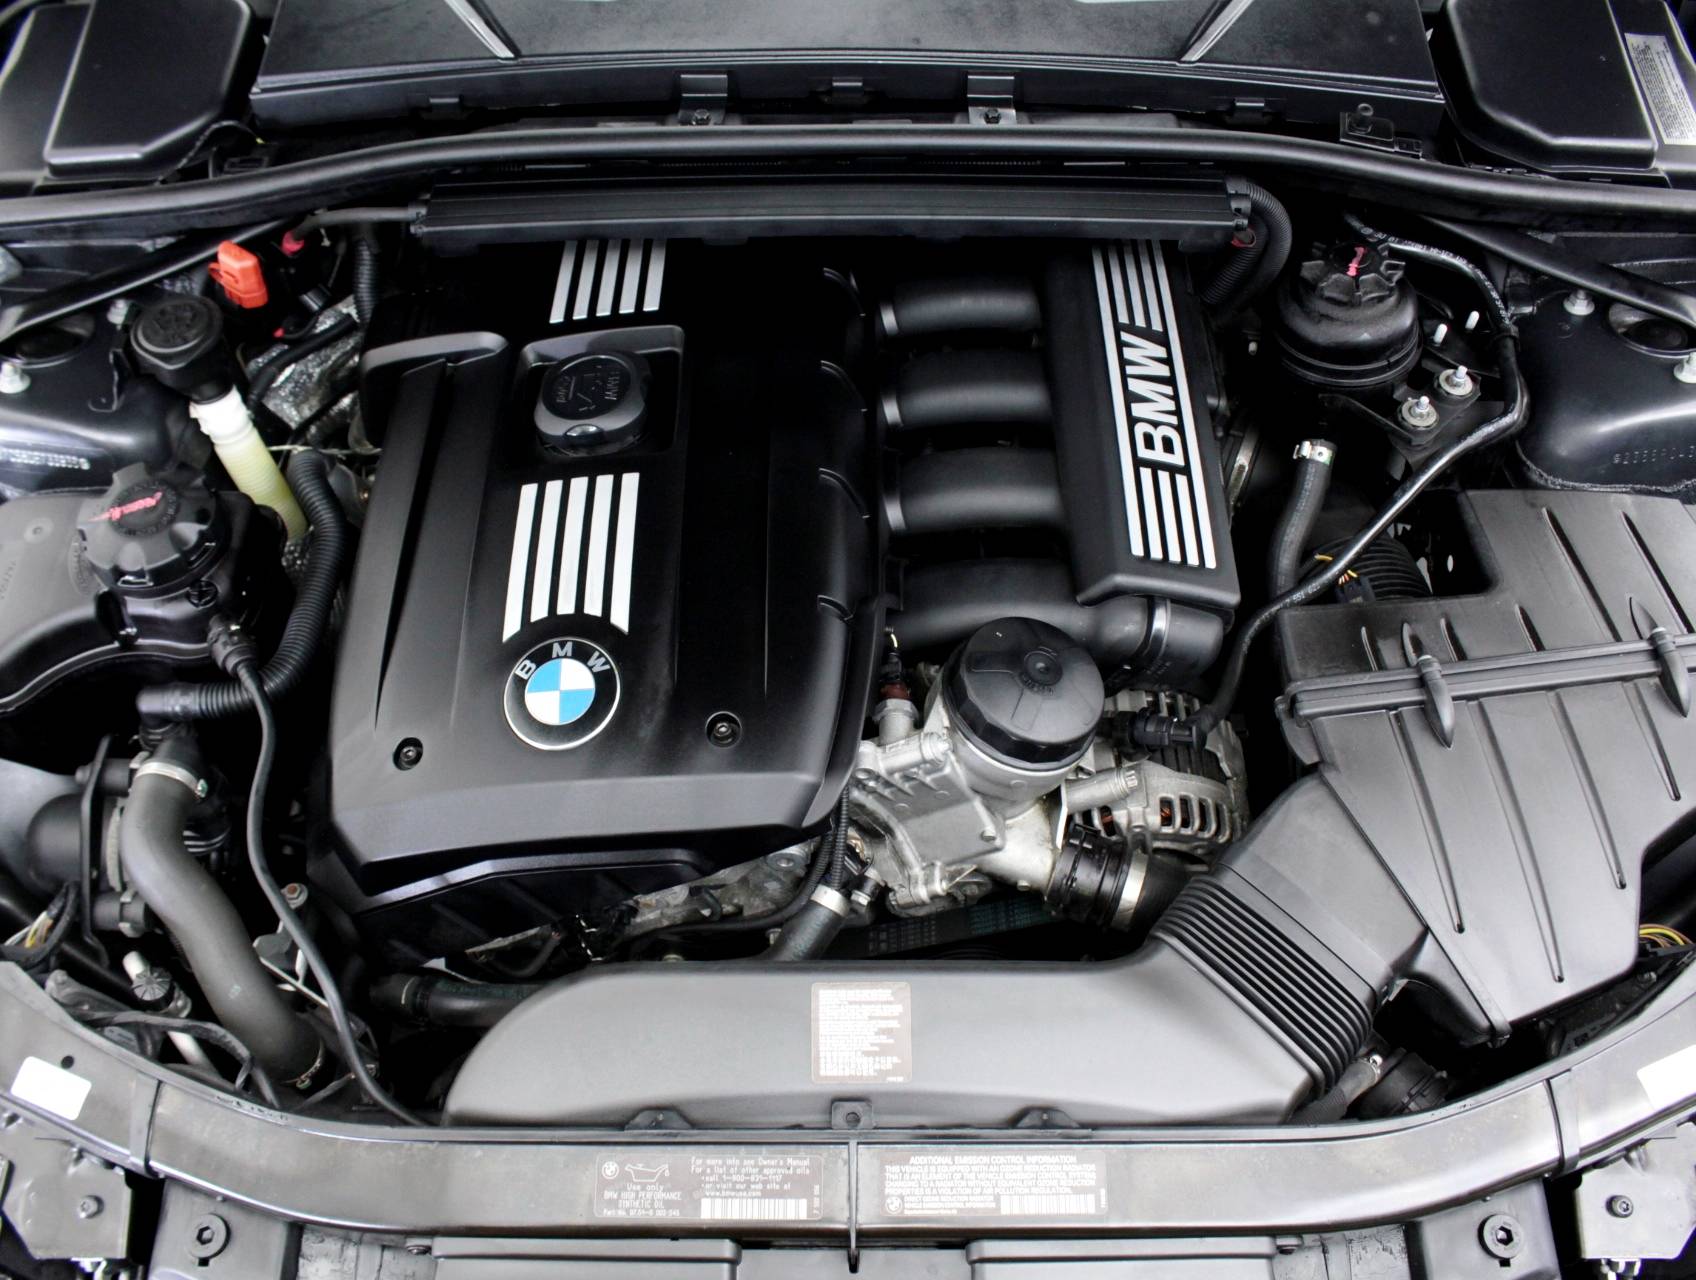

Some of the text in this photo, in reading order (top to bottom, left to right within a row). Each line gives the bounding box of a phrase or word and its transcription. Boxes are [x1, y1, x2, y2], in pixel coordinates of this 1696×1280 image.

[1120, 331, 1186, 467] BMW
[515, 641, 611, 680] BMW
[786, 1158, 810, 1166] Manual
[909, 1156, 953, 1164] ADDITIONAL
[646, 1182, 664, 1191] only
[638, 1191, 682, 1200] PERFORMANCE
[654, 1200, 664, 1208] OIL
